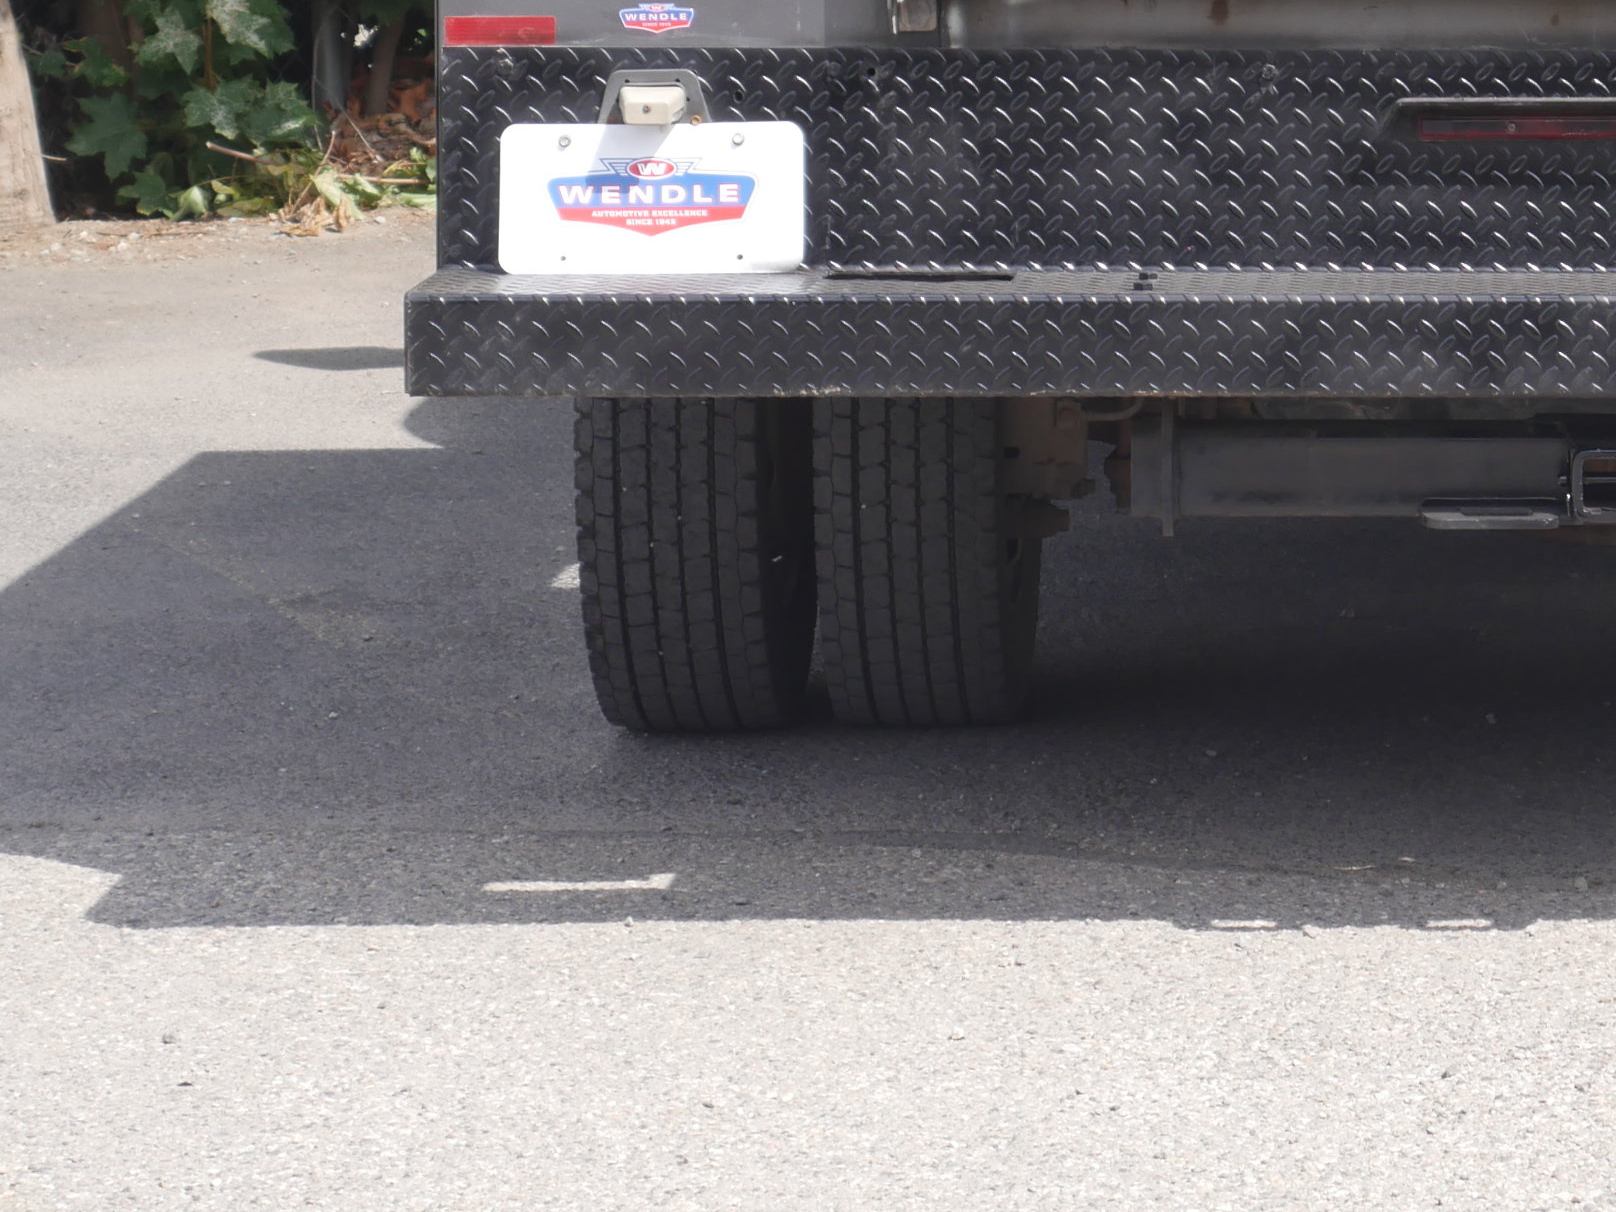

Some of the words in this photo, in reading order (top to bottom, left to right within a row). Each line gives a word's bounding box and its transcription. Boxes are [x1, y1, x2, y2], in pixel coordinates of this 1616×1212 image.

[624, 13, 687, 21] WENDLE
[558, 183, 740, 205] WENDLE
[591, 210, 649, 218] AUTOMOTIVE
[652, 209, 708, 217] EXCELLENCE
[625, 218, 653, 226] SINCE
